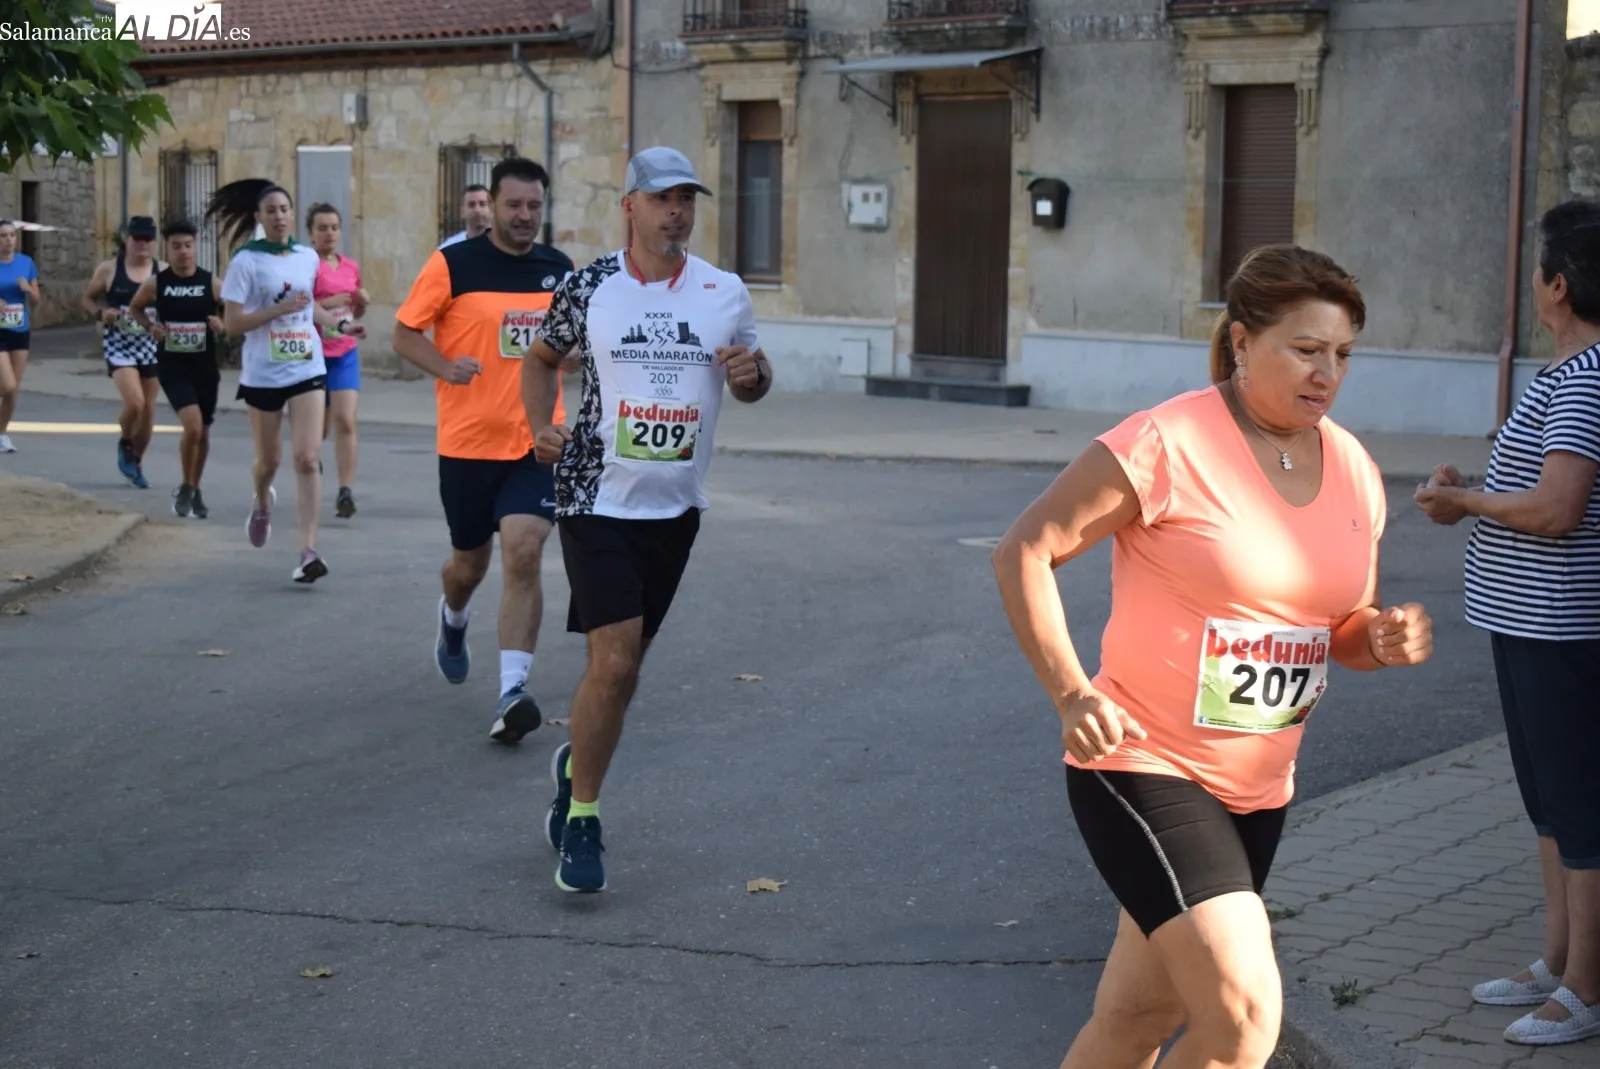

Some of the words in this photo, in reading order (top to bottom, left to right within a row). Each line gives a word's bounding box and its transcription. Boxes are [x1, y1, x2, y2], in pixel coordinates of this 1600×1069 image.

[163, 285, 206, 297] NIKE
[503, 313, 542, 327] bedun
[174, 334, 198, 345] 230
[511, 327, 541, 346] 21
[279, 340, 306, 353] 208
[610, 349, 650, 360] MEDIA
[653, 350, 713, 363] MARATÓN
[649, 372, 679, 385] 2021
[618, 399, 699, 423] bedunia
[632, 421, 686, 448] 209
[1205, 628, 1326, 665] bedunia
[1229, 663, 1311, 707] 207
